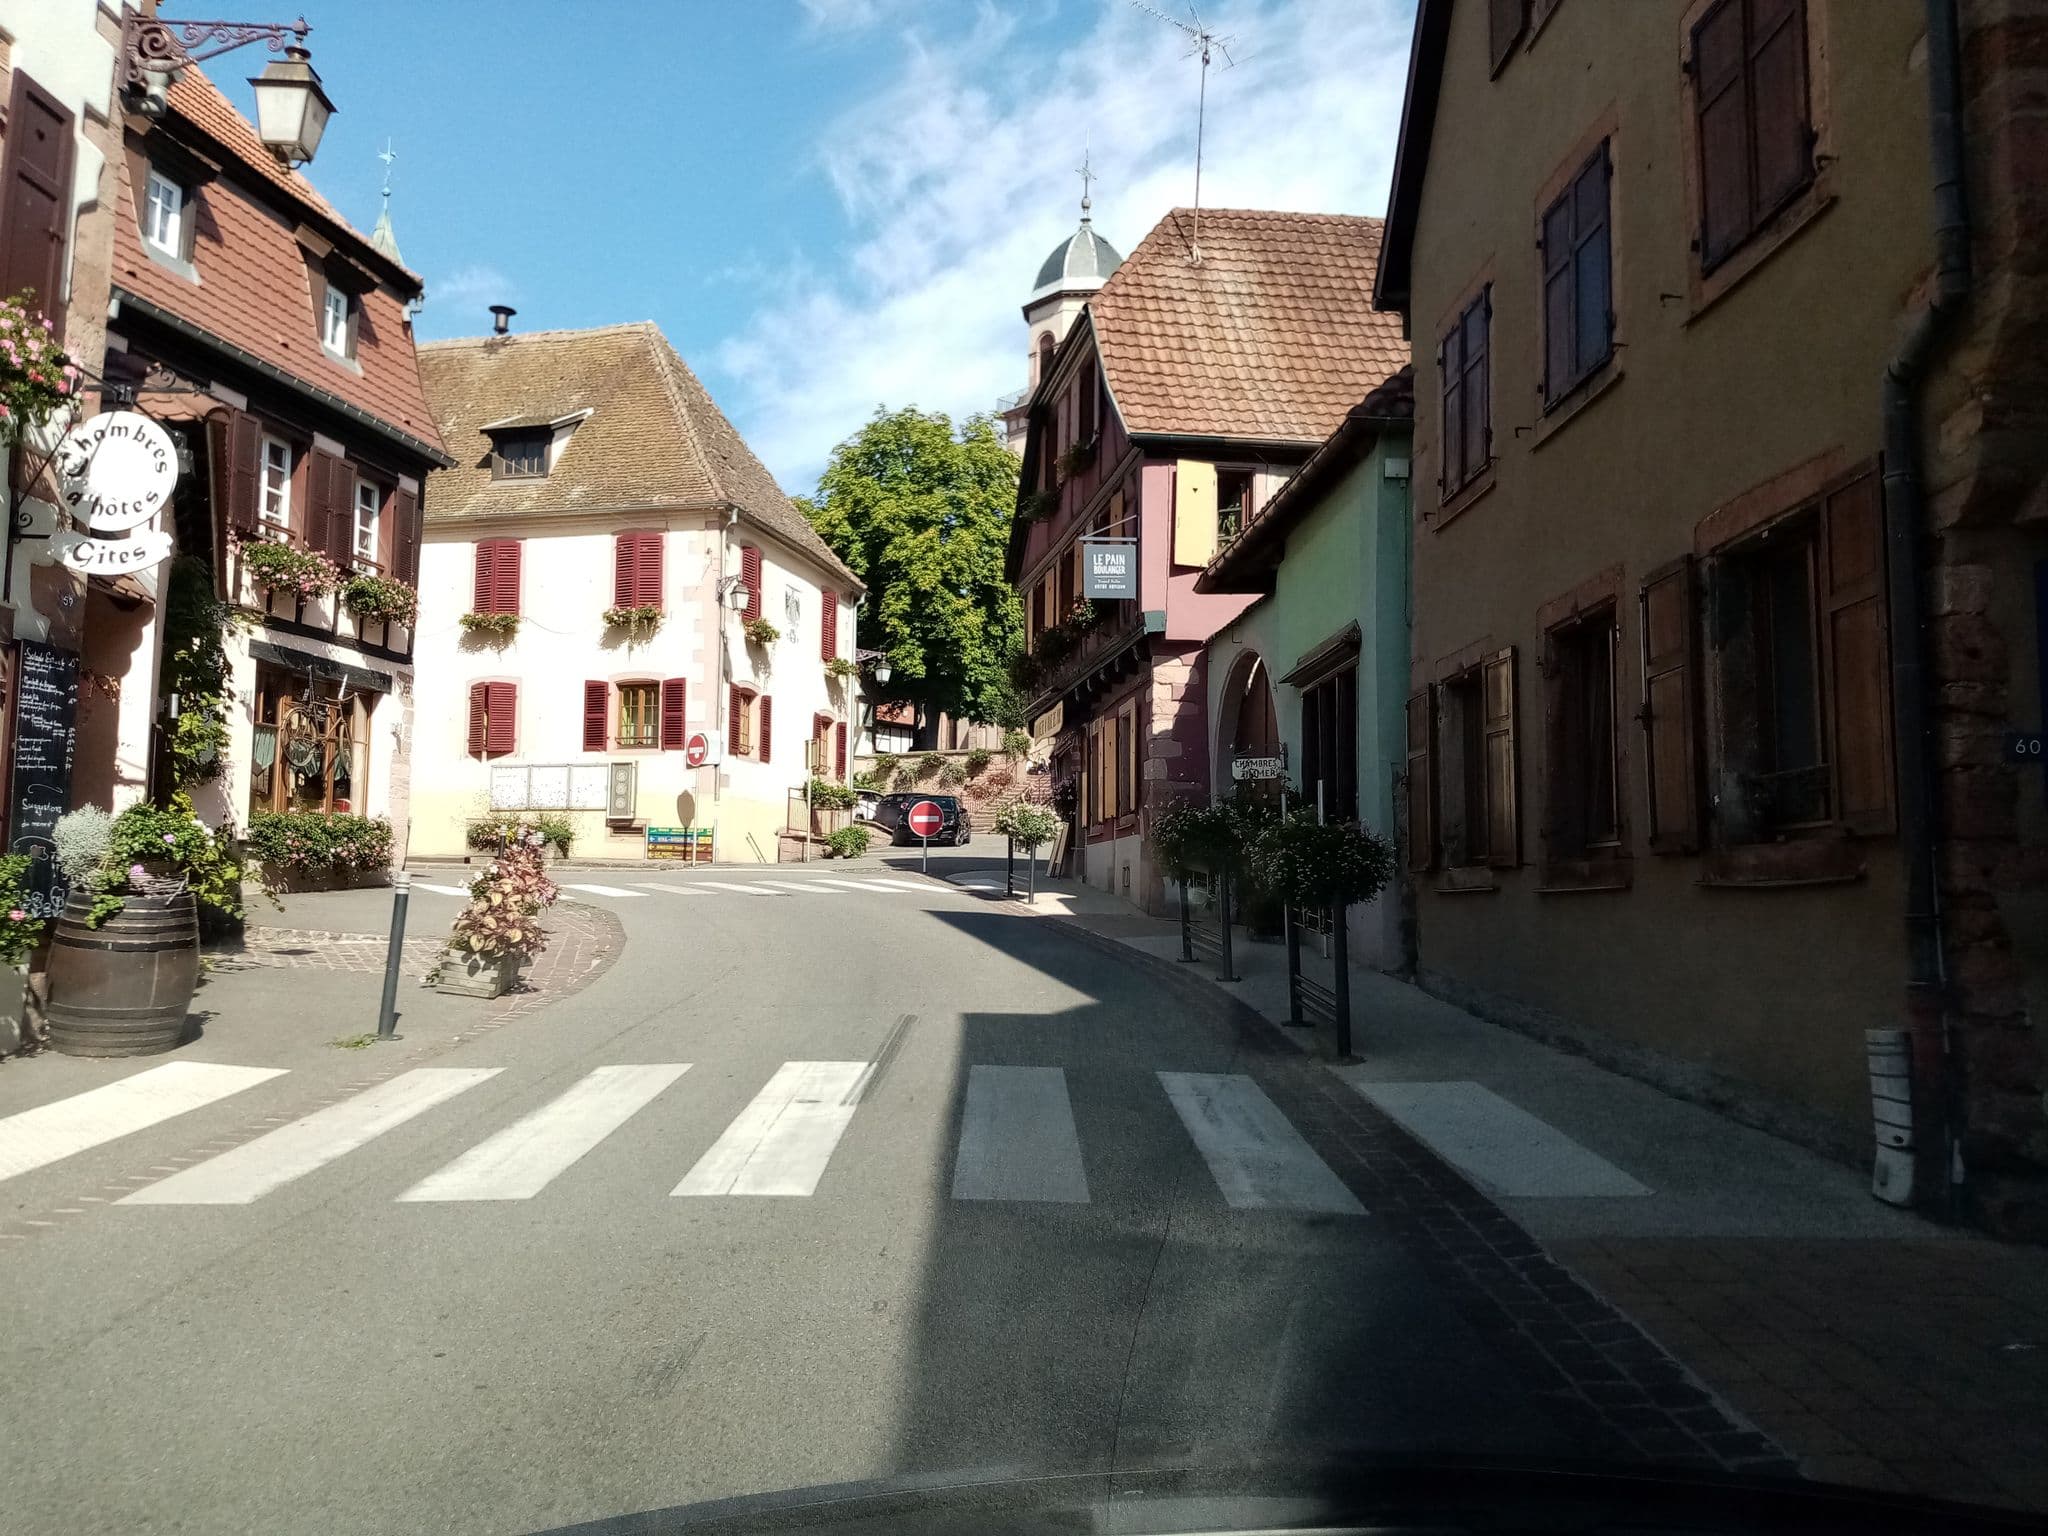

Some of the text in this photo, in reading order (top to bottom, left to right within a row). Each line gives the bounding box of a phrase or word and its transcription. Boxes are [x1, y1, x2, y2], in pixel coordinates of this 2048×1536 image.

[62, 424, 168, 478] Chambres
[1093, 553, 1126, 566] LE PAIN
[1093, 565, 1126, 575] BOULANGER
[2015, 739, 2041, 754] 60
